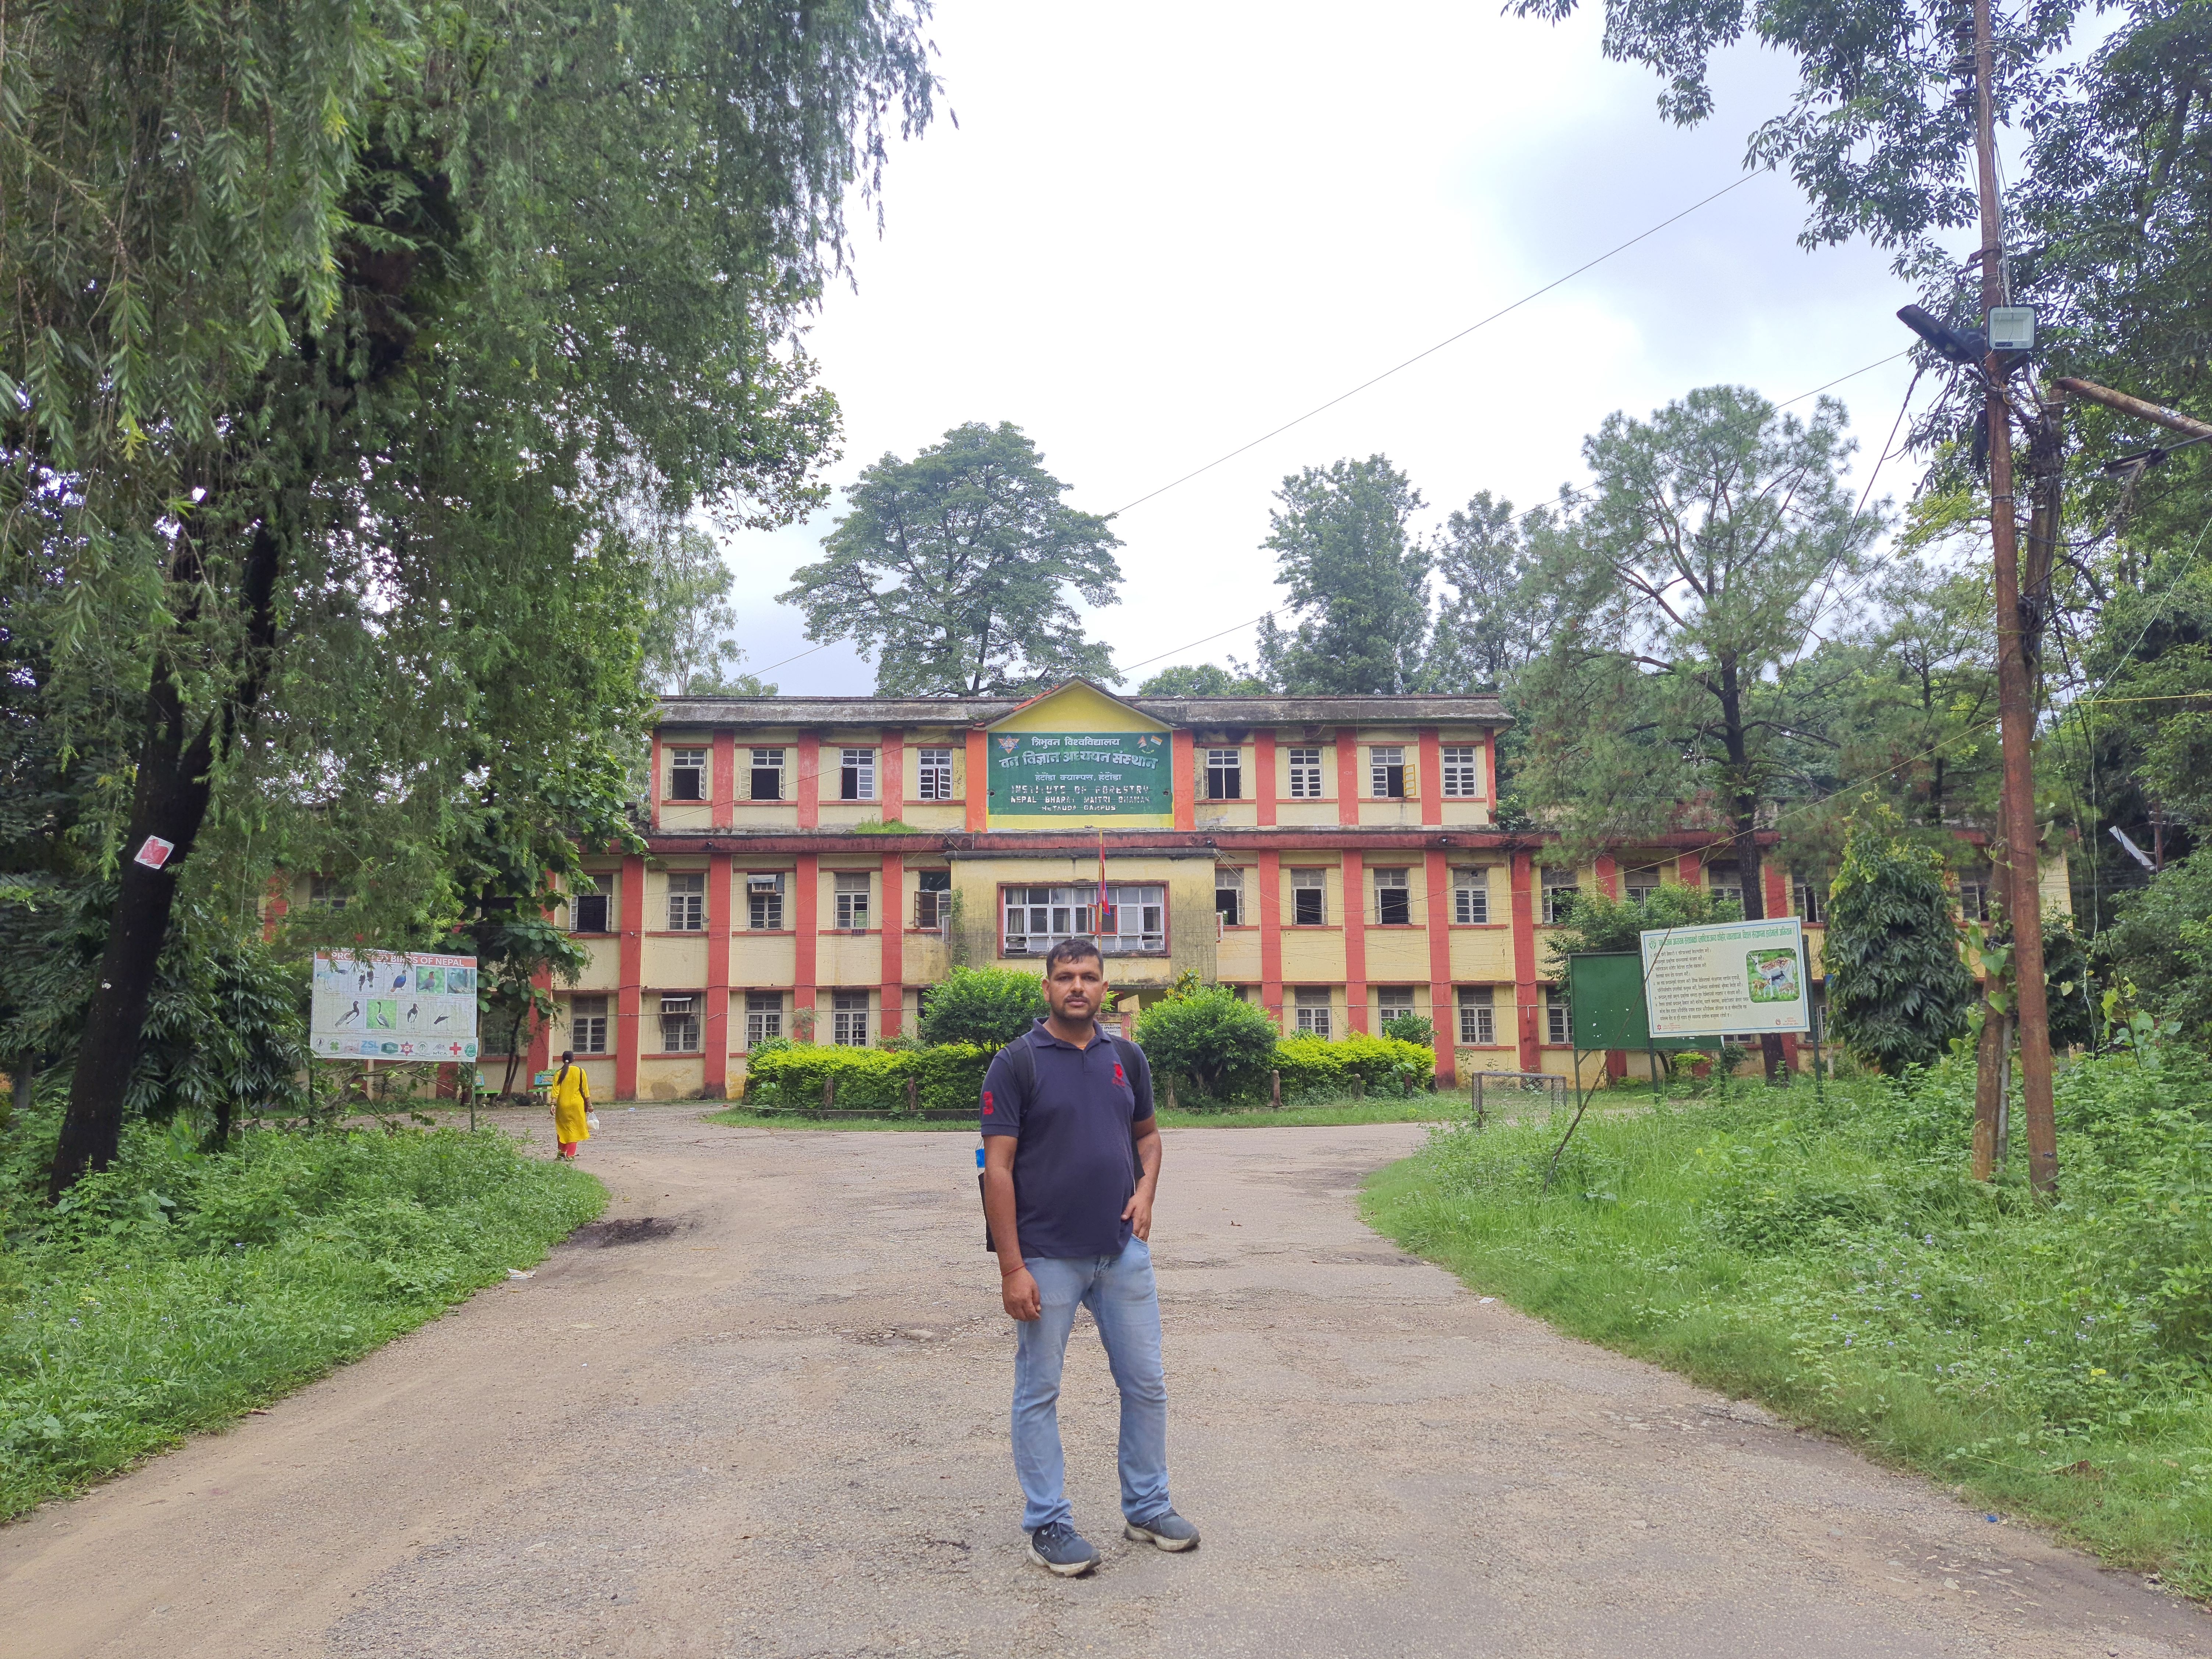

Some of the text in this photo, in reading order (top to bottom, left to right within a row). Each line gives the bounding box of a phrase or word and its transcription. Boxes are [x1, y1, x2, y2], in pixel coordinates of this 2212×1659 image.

[1031, 736, 1121, 749] त्रिभुवन विश्वविद्यालय
[999, 750, 1159, 769] वन विज्ञान अध्ययन संस्थान
[1074, 786, 1086, 794] OF
[1095, 785, 1149, 794] FORESTRY
[1663, 937, 1672, 946] ज्ञान
[436, 958, 464, 966] NEPAL
[361, 1040, 379, 1048] ZSL
